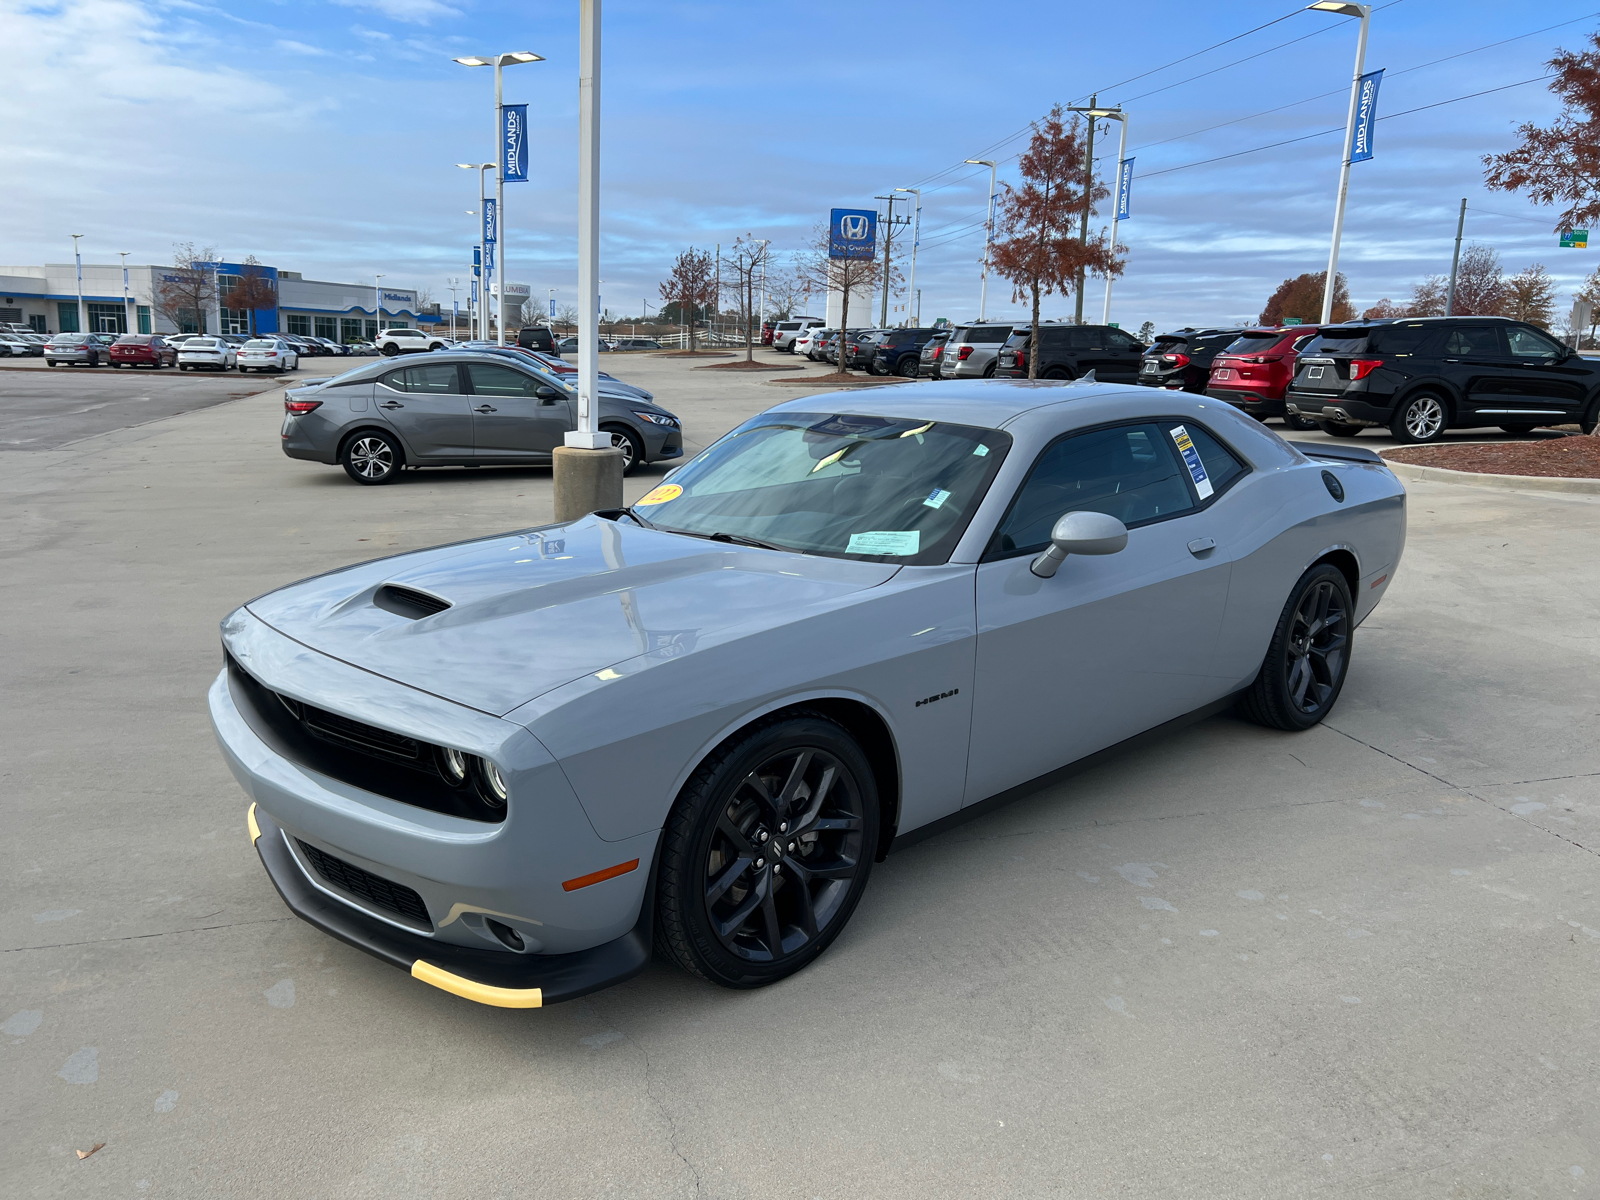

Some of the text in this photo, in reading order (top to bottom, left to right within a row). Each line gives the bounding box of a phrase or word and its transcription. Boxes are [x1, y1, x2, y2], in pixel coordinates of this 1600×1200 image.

[1356, 80, 1372, 153] MIDLANDS
[507, 110, 516, 175] MIDLANDS
[1119, 163, 1129, 214] MIDLANDS
[163, 275, 207, 285] HOA
[494, 285, 528, 294] CUMBIA
[384, 293, 412, 302] Midlands
[915, 688, 959, 708] HEMI
